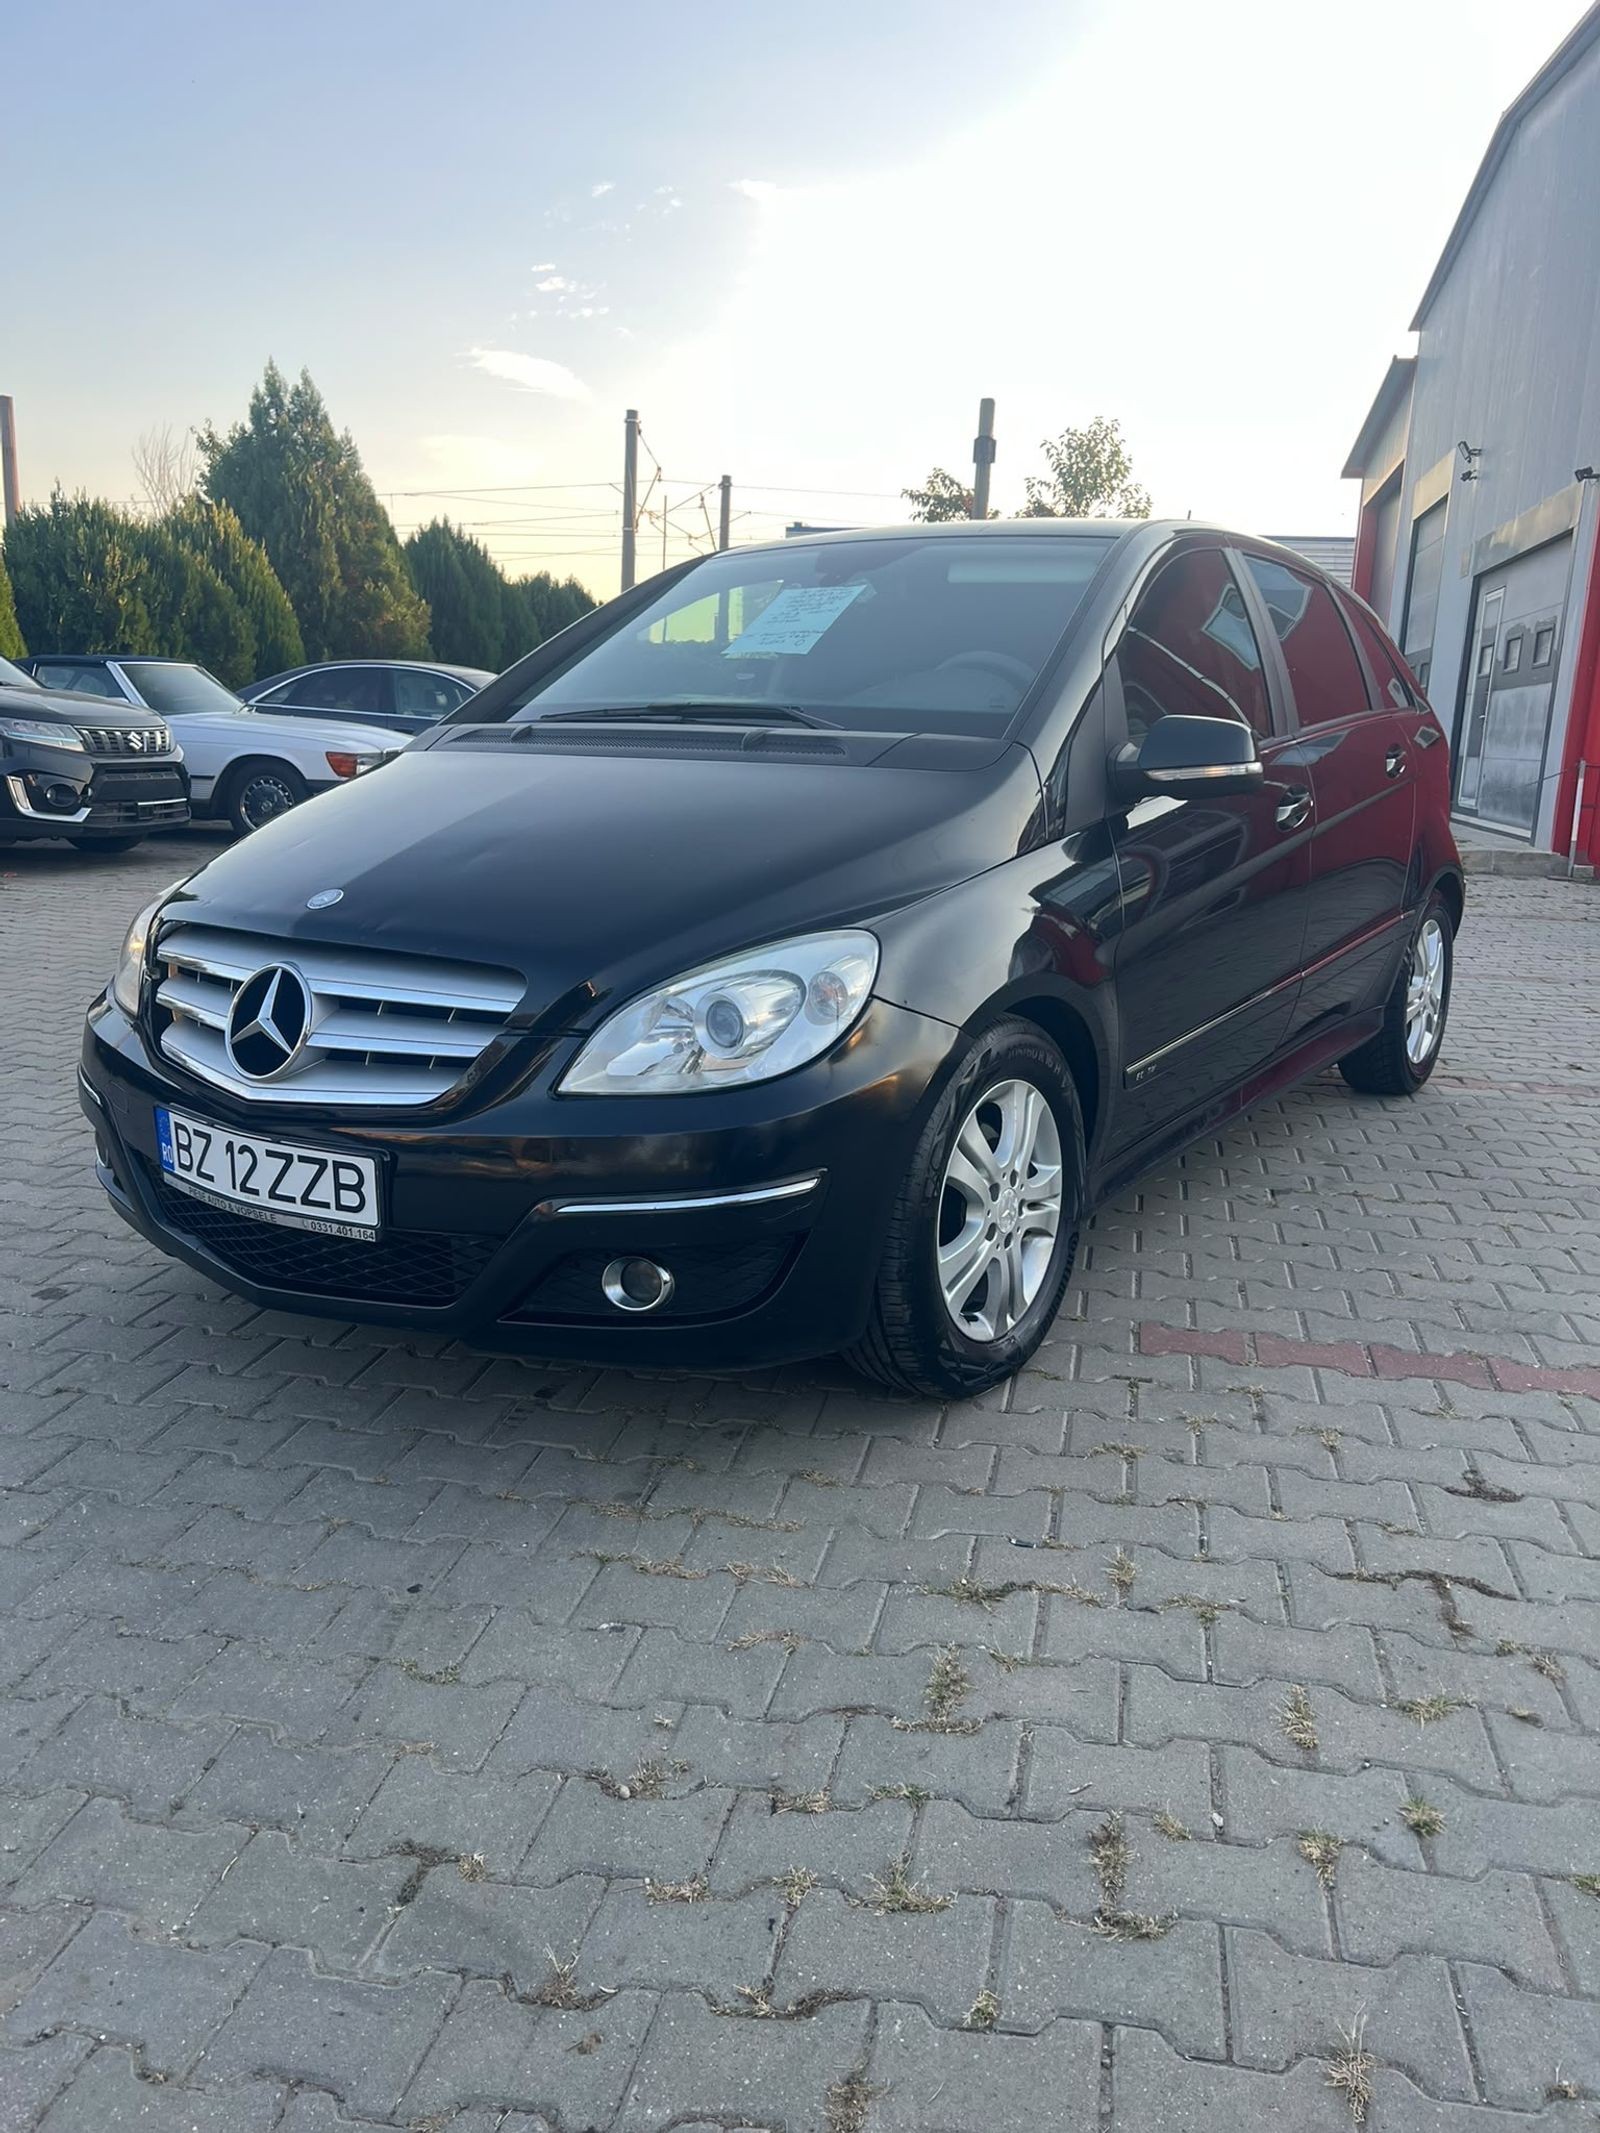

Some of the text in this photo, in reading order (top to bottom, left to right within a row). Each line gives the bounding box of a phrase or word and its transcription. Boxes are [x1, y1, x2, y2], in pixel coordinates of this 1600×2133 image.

[161, 1142, 173, 1164] RO
[174, 1121, 366, 1213] BZ 12 ZZB
[207, 1194, 227, 1209] AUTO
[235, 1204, 277, 1223] VOPSELE
[310, 1221, 374, 1240] 0331.401.164
